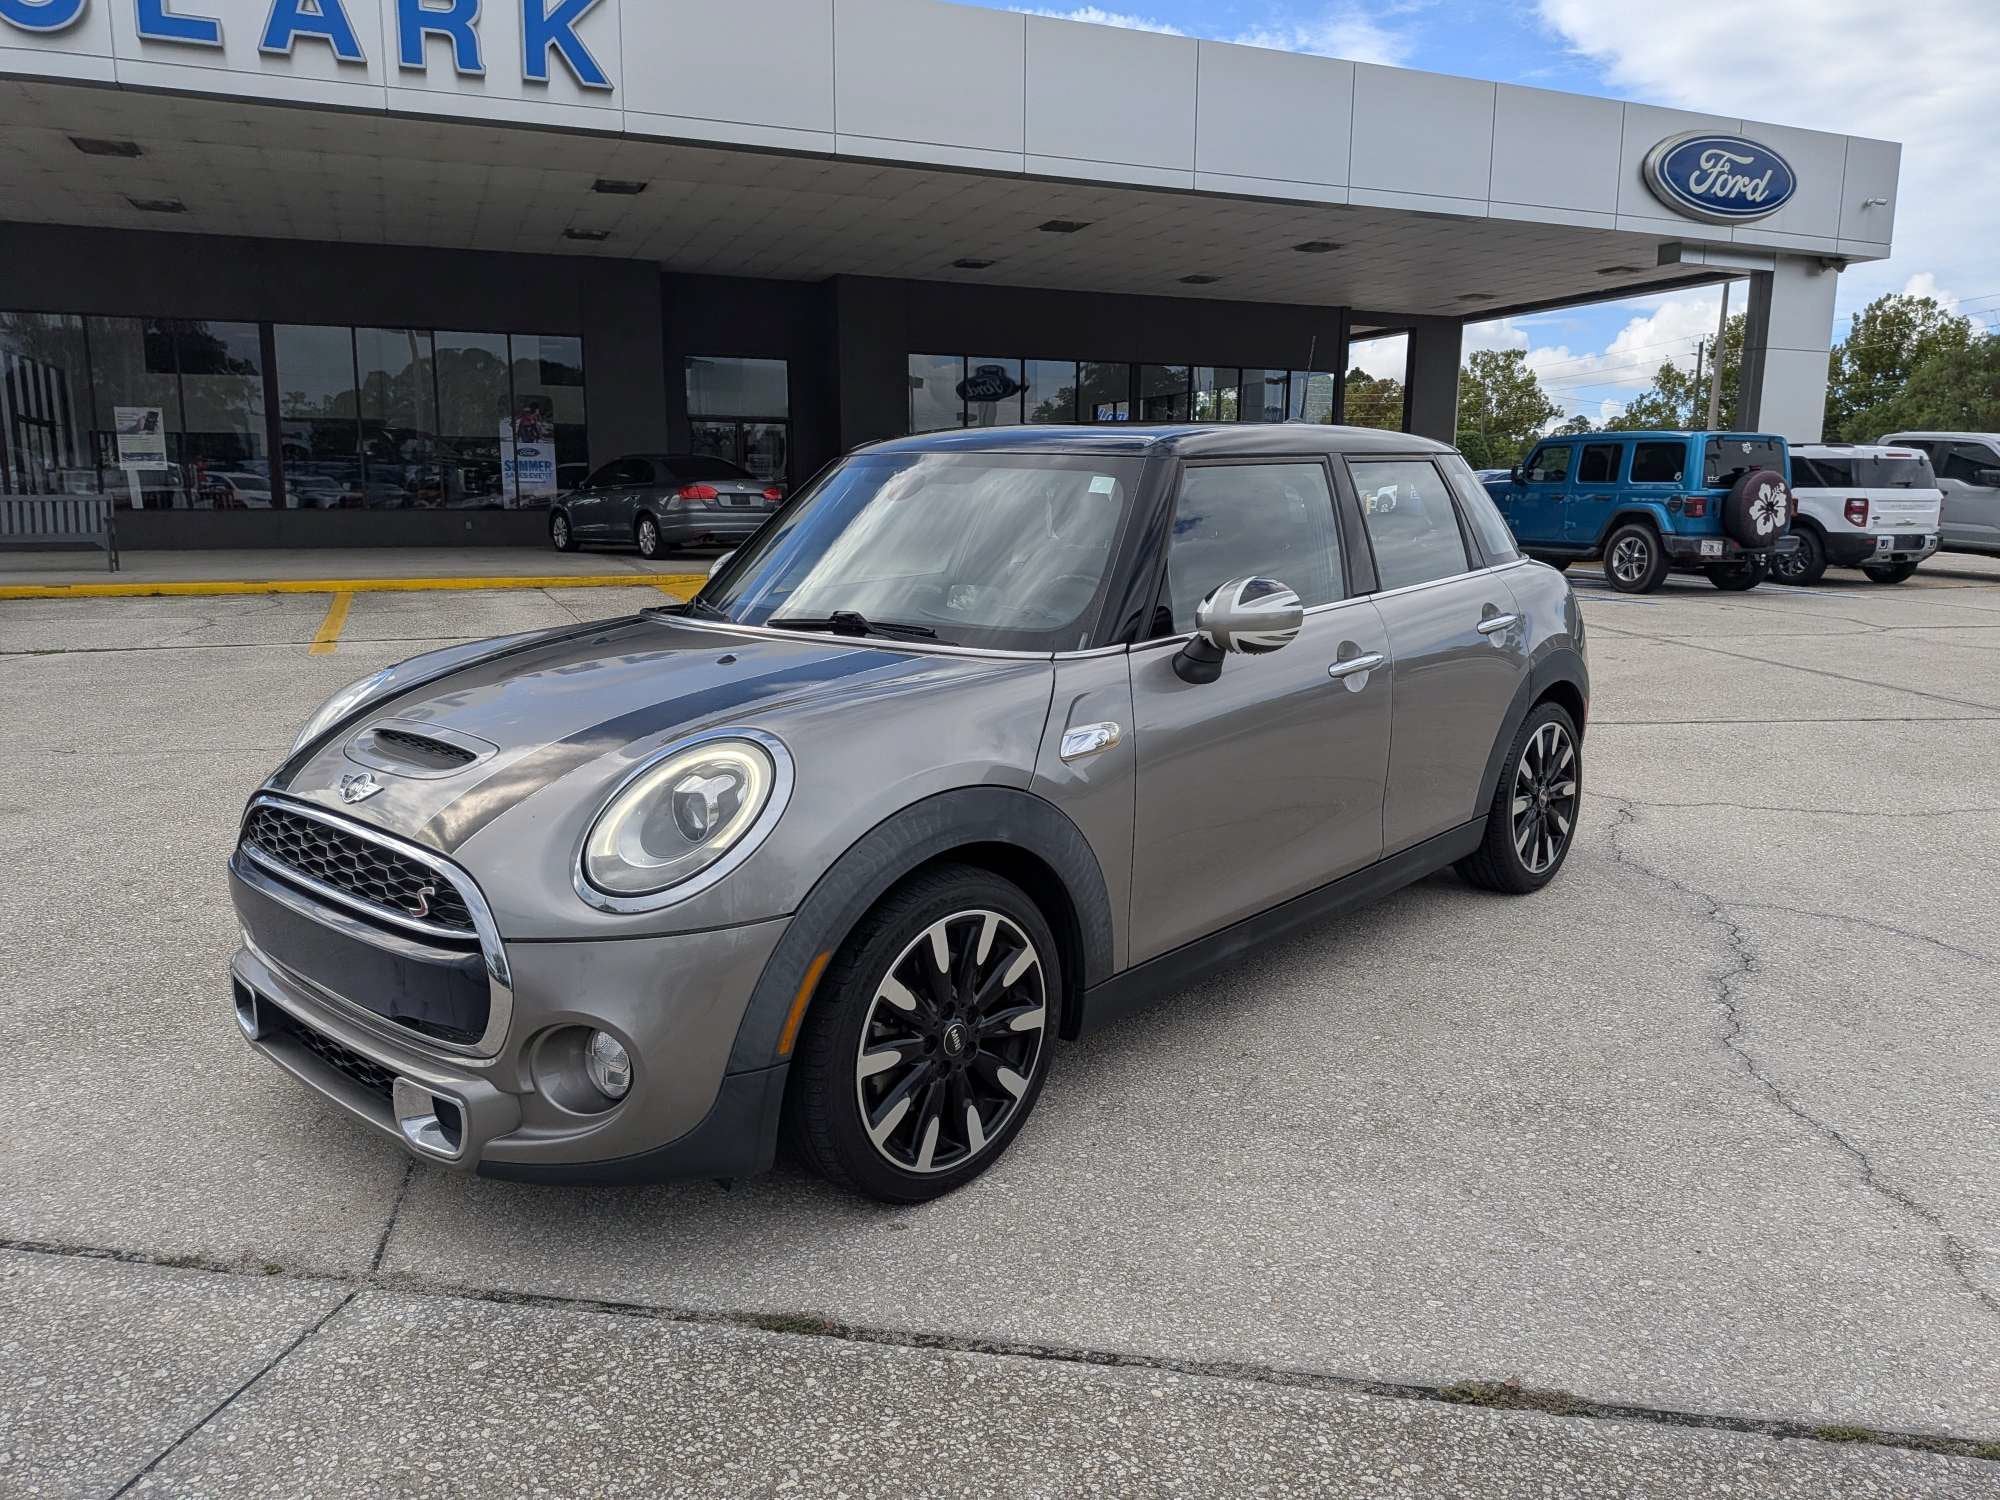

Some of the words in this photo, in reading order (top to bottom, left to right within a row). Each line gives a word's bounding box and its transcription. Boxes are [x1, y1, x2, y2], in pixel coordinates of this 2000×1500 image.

[1689, 149, 1772, 202] Ford
[504, 460, 552, 472] SMMER
[408, 886, 435, 917] S
[951, 1029, 961, 1051] MINI
